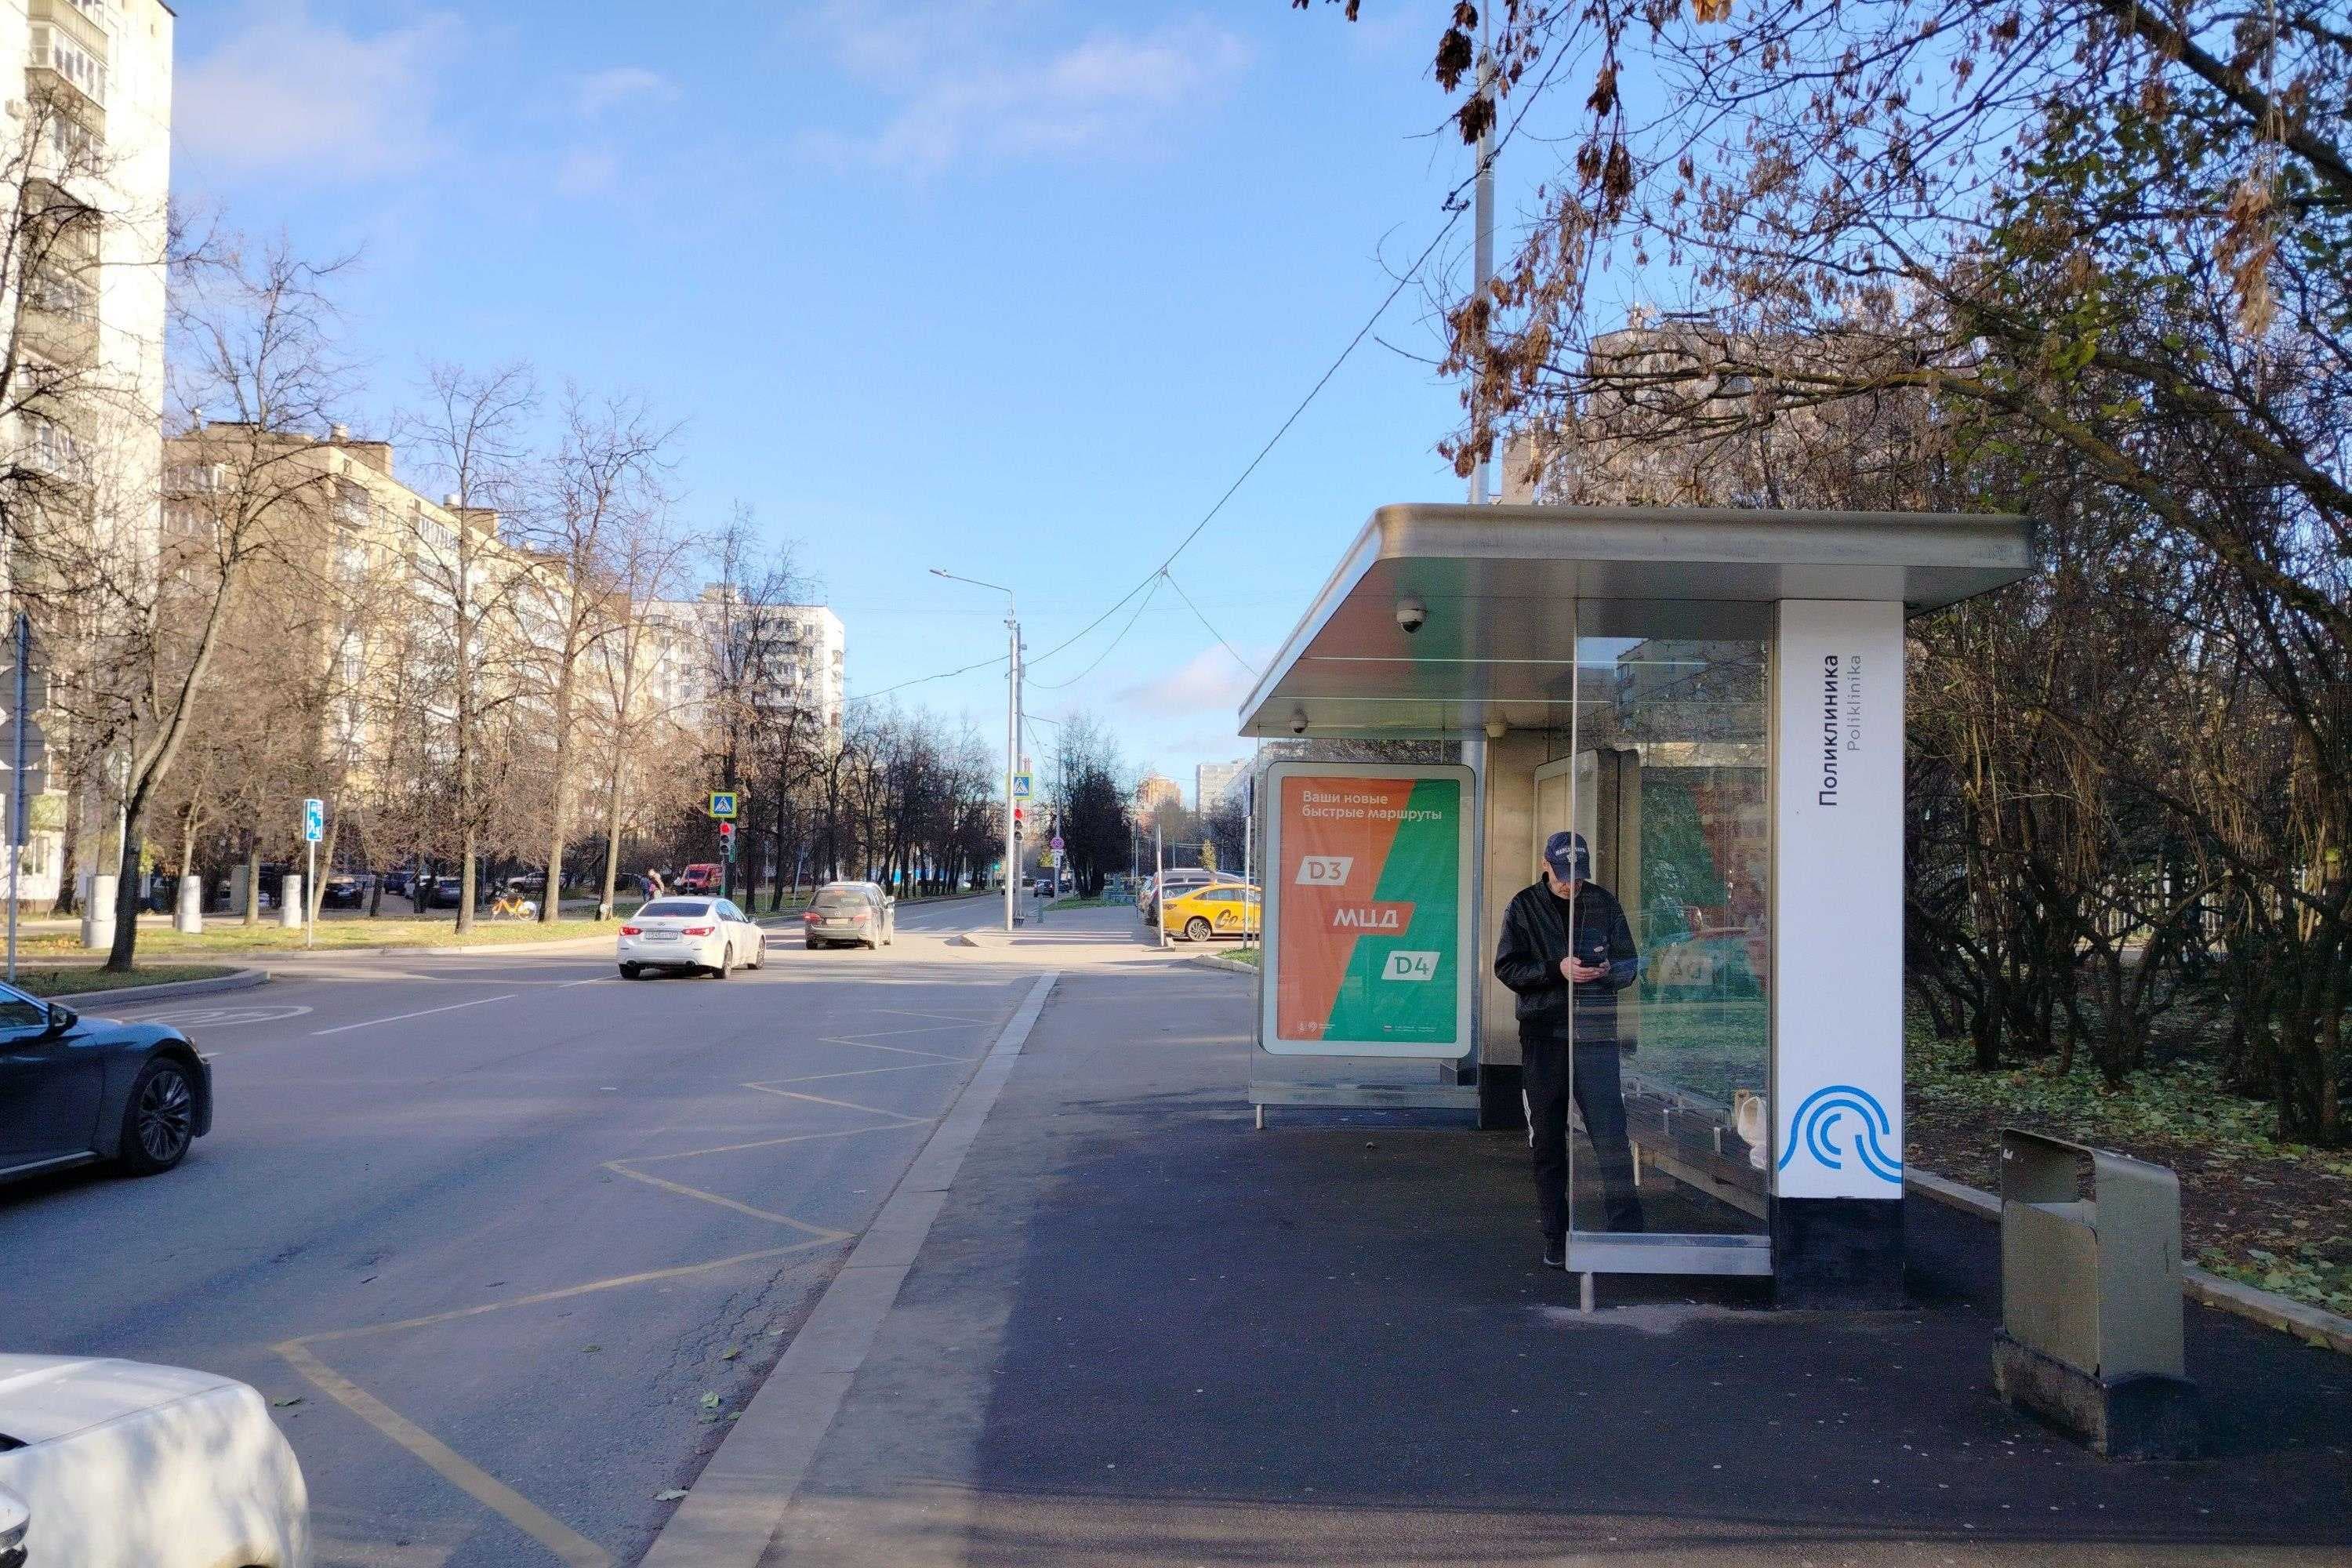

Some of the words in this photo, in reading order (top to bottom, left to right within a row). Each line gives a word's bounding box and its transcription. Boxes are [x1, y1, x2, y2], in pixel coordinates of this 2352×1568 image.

[1847, 655, 1861, 751] Poliklinika
[1819, 655, 1838, 806] Поликлиника
[1303, 790, 1340, 803] Ваши
[1344, 794, 1388, 804] новые
[1302, 805, 1365, 820] быстрые
[1368, 808, 1443, 822] маршруты
[1308, 862, 1341, 880] D3
[1333, 908, 1399, 928] МЦД
[1394, 956, 1430, 975] D4
